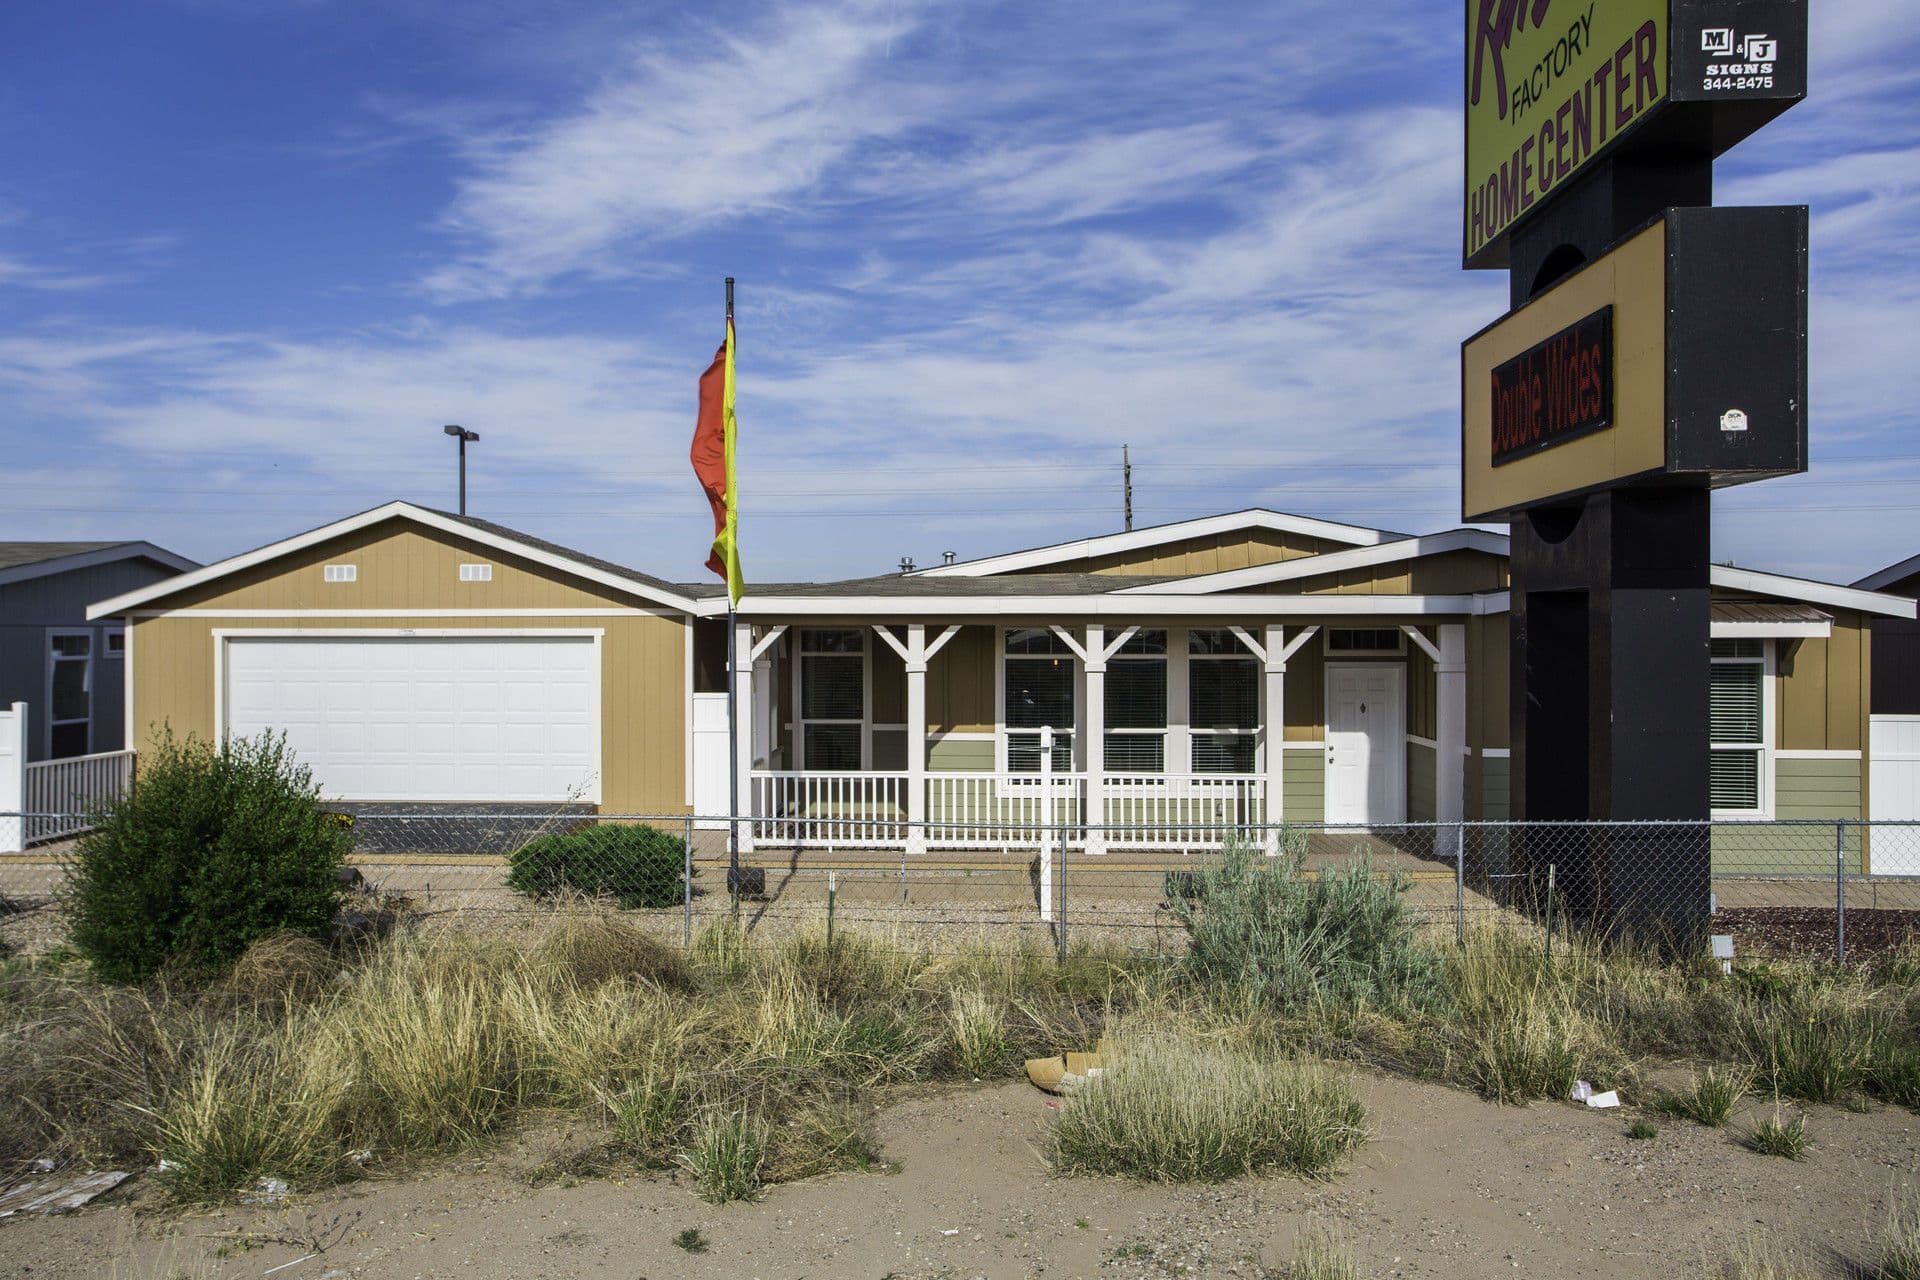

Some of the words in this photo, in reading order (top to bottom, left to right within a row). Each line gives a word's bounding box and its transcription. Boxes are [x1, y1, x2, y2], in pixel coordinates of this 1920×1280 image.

[1736, 44, 1743, 53] &
[1512, 3, 1594, 125] FACTORY
[1706, 63, 1773, 75] SIGNS
[1703, 76, 1773, 90] 344-2475
[1492, 352, 1542, 455] Double
[1546, 327, 1601, 433] Wides
